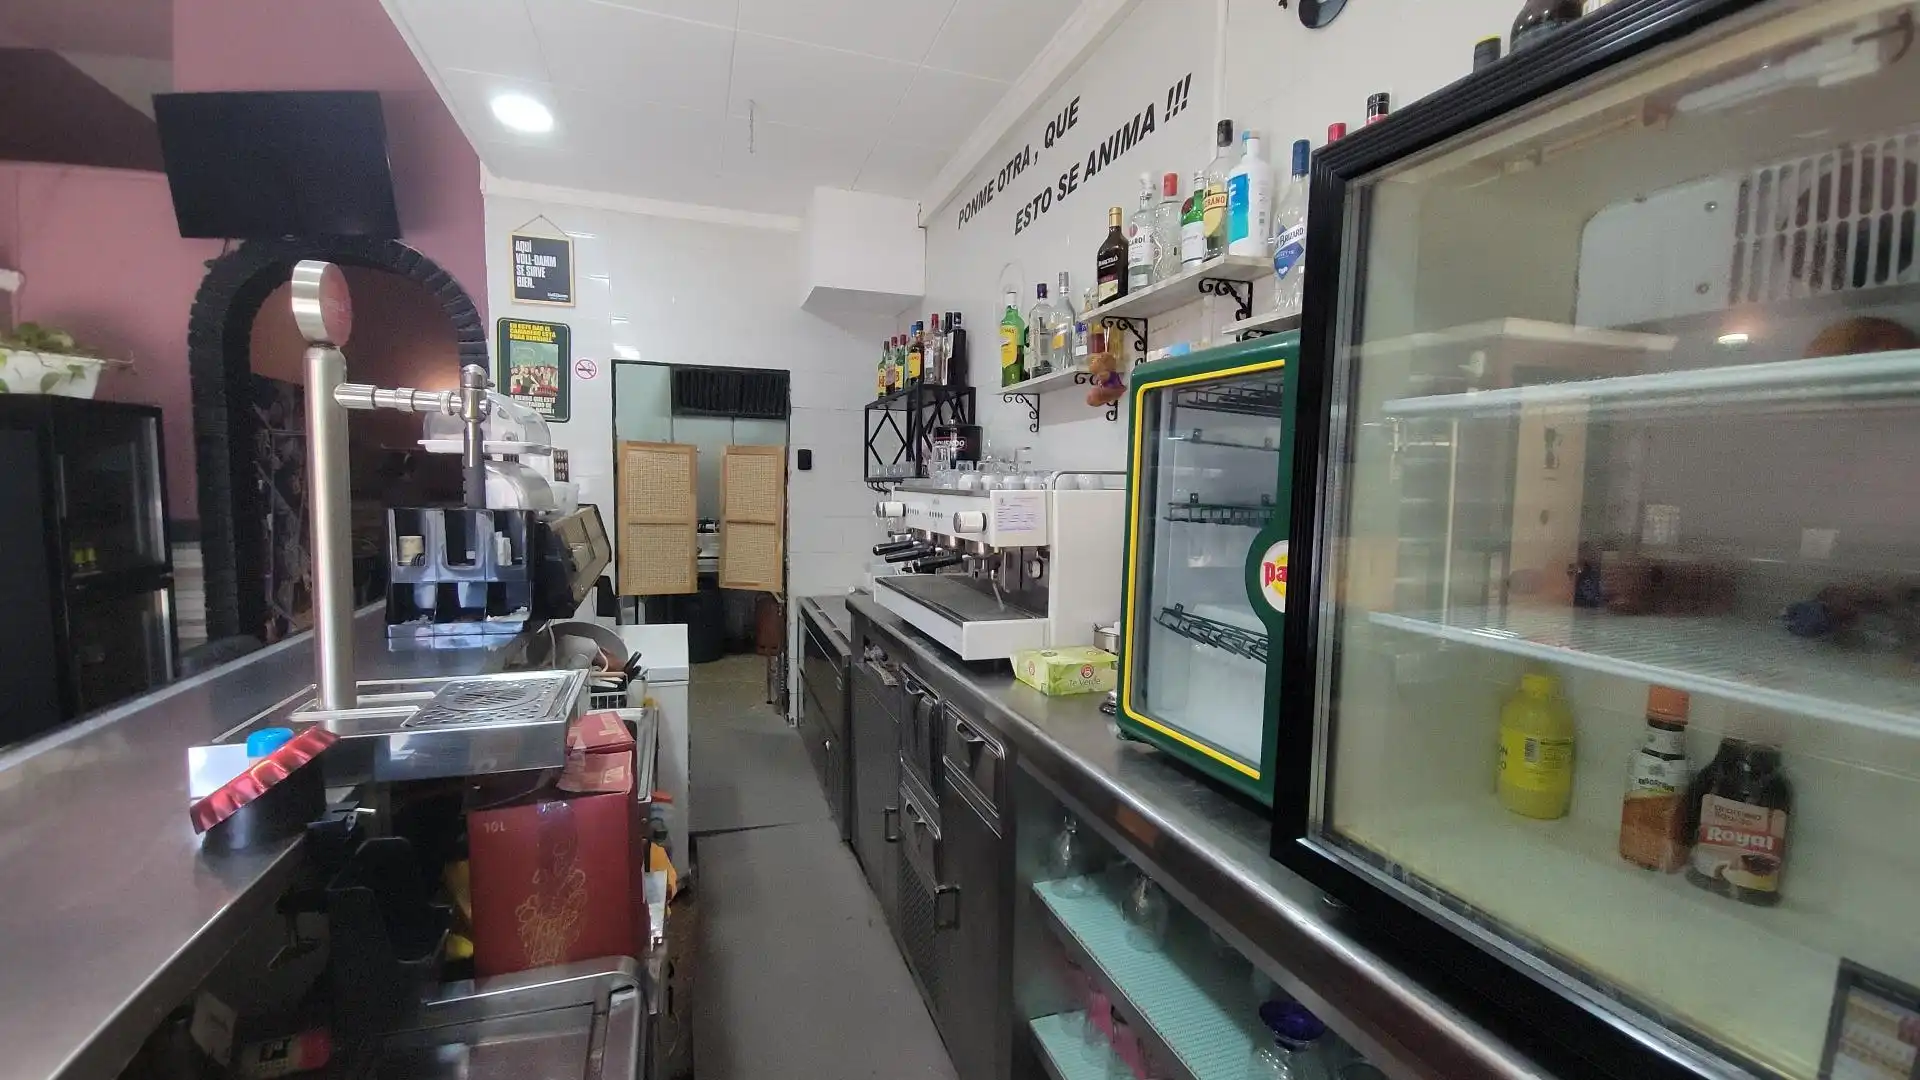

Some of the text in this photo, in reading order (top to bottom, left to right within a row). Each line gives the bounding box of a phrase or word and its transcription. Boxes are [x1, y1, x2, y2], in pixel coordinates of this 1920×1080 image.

[958, 179, 994, 230] PONME
[1044, 95, 1080, 149] QUE
[1014, 186, 1051, 236] ESTO
[1057, 162, 1080, 202] SE
[1083, 103, 1155, 183] ANIMA
[516, 265, 546, 278] SE SIRVE
[1263, 561, 1287, 587] Pa
[1707, 826, 1774, 850] Royal
